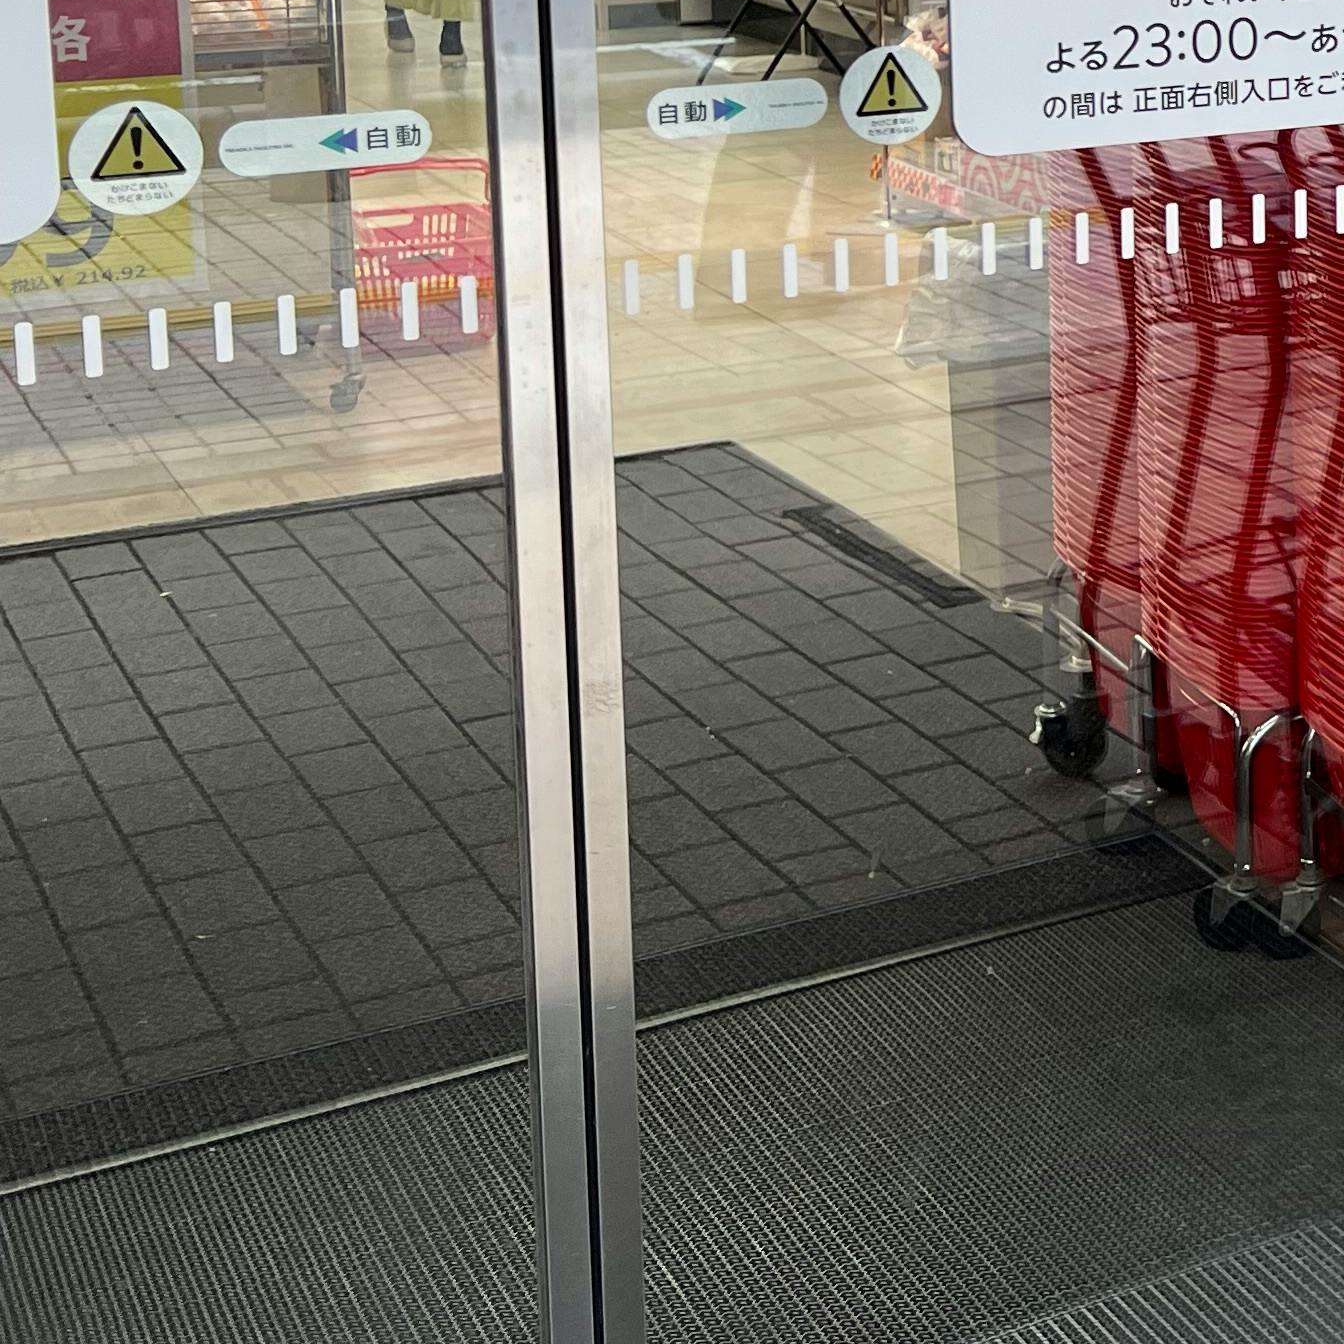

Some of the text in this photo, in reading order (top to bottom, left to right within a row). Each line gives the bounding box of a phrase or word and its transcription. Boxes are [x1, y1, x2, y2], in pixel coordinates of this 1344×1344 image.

[658, 100, 707, 126] 自動
[1042, 89, 1125, 120] の間は
[366, 123, 422, 151] 自動
